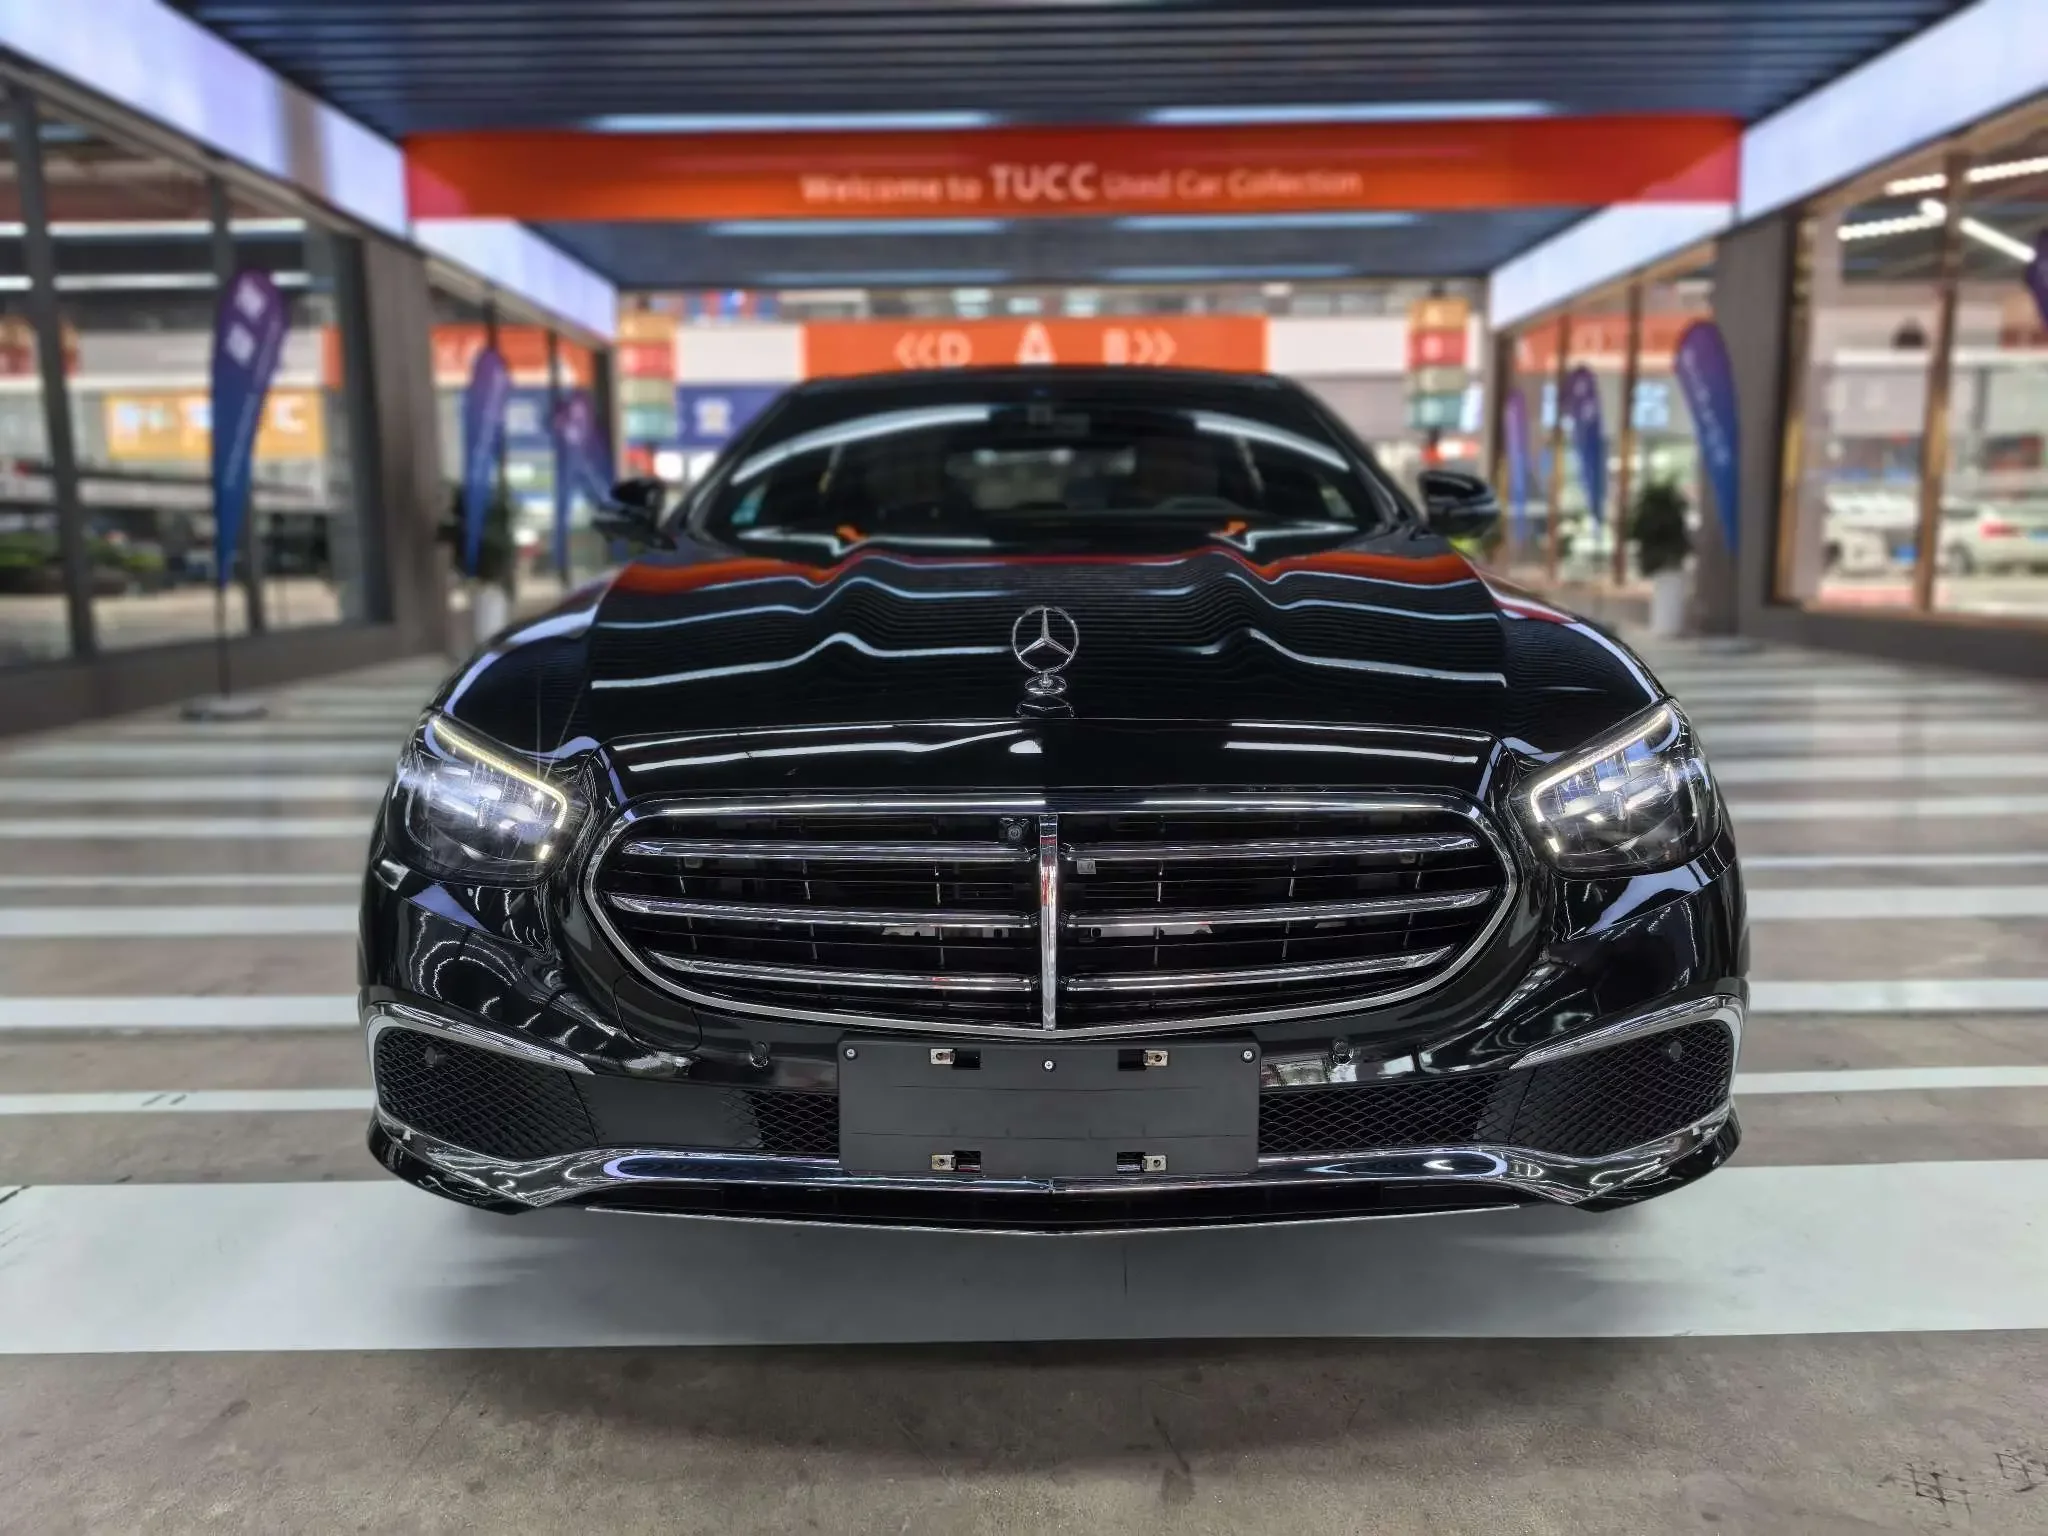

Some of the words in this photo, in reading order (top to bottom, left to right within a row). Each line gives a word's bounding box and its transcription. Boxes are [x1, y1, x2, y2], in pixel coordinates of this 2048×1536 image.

[801, 175, 943, 202] Welcome
[946, 175, 982, 202] to
[990, 163, 1097, 202] TUCC
[1176, 169, 1224, 199] Car
[1228, 168, 1364, 199] Collection
[937, 329, 972, 368] D
[1014, 320, 1057, 365] A
